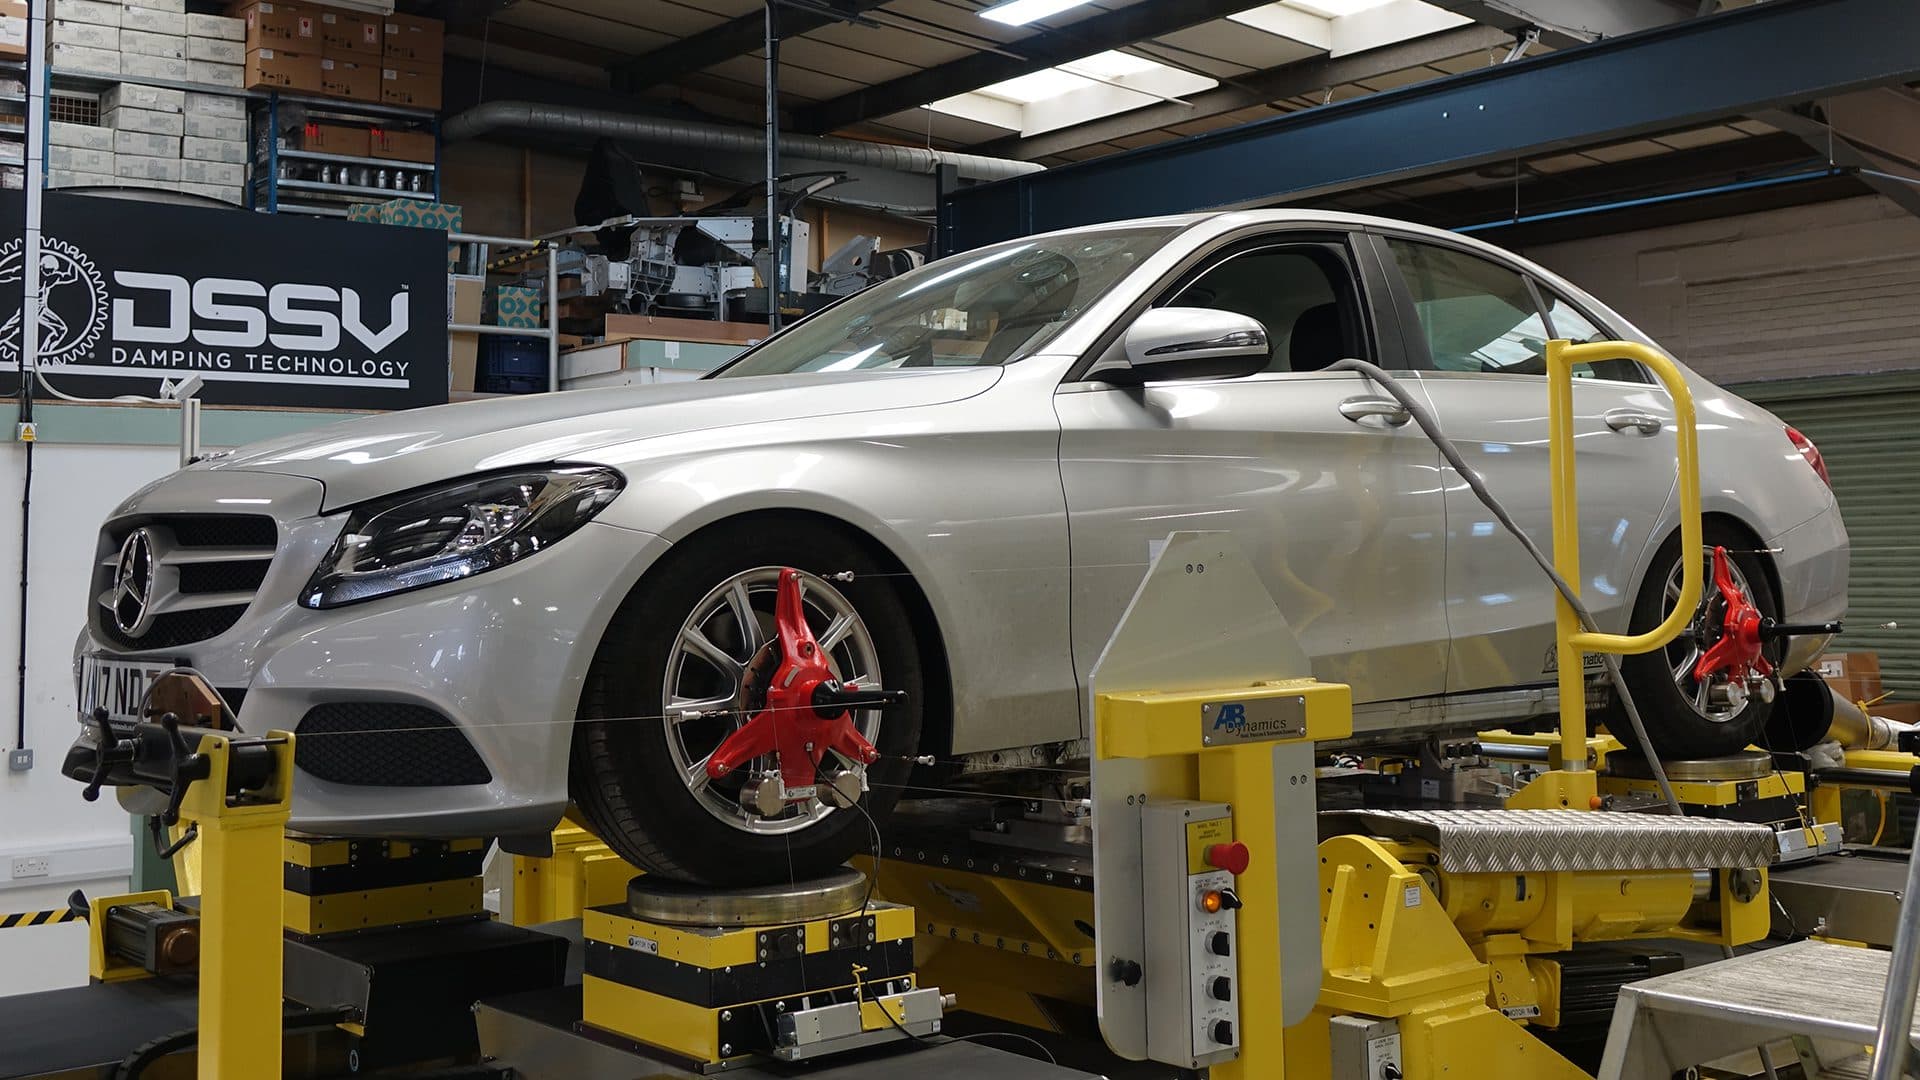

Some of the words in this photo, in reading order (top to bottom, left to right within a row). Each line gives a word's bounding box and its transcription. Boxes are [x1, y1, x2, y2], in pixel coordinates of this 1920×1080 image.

[112, 270, 409, 354] DSSV
[112, 347, 232, 369] DAMPING
[245, 353, 410, 378] TECHNOLOGY
